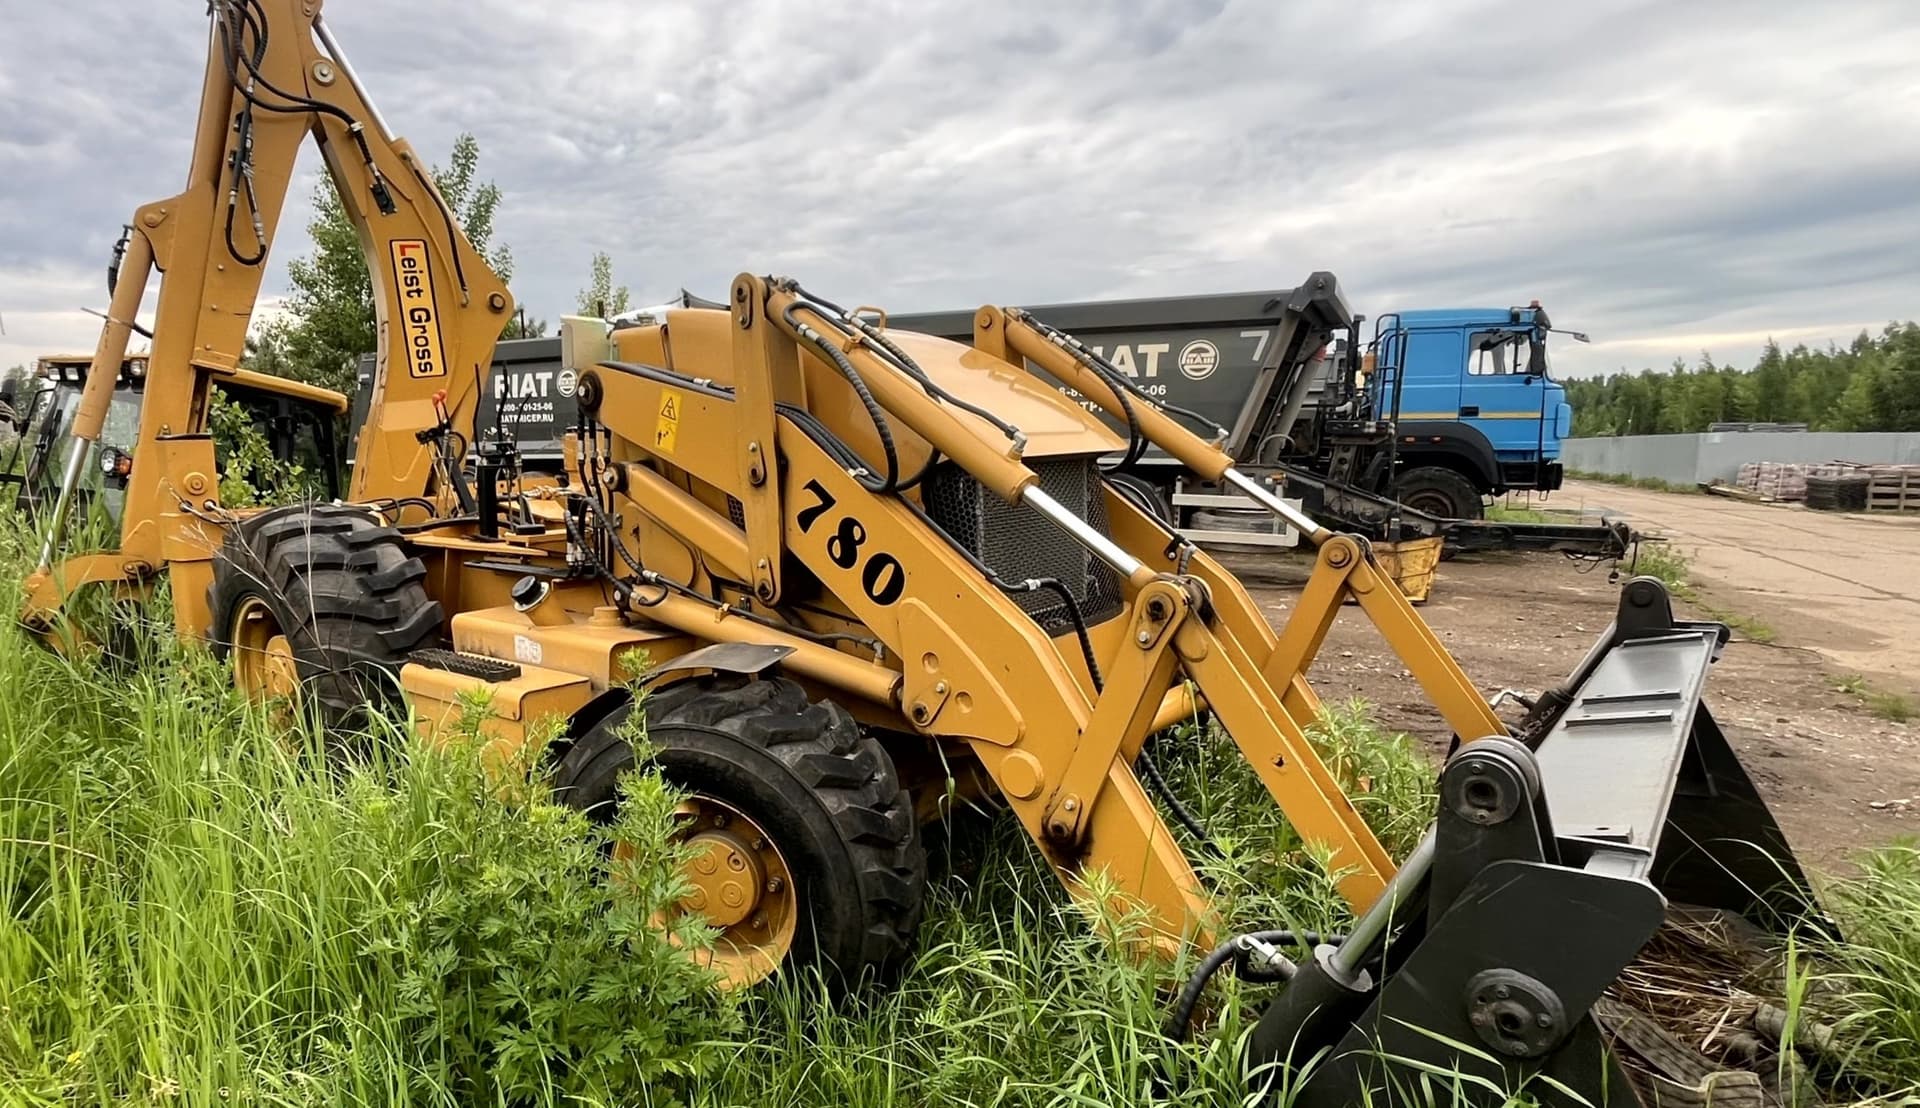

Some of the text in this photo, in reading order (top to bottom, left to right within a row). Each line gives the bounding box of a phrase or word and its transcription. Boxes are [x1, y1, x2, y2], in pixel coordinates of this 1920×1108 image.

[399, 244, 433, 373] Leist Gross
[494, 372, 553, 399] RIAT
[797, 479, 905, 606] 780
